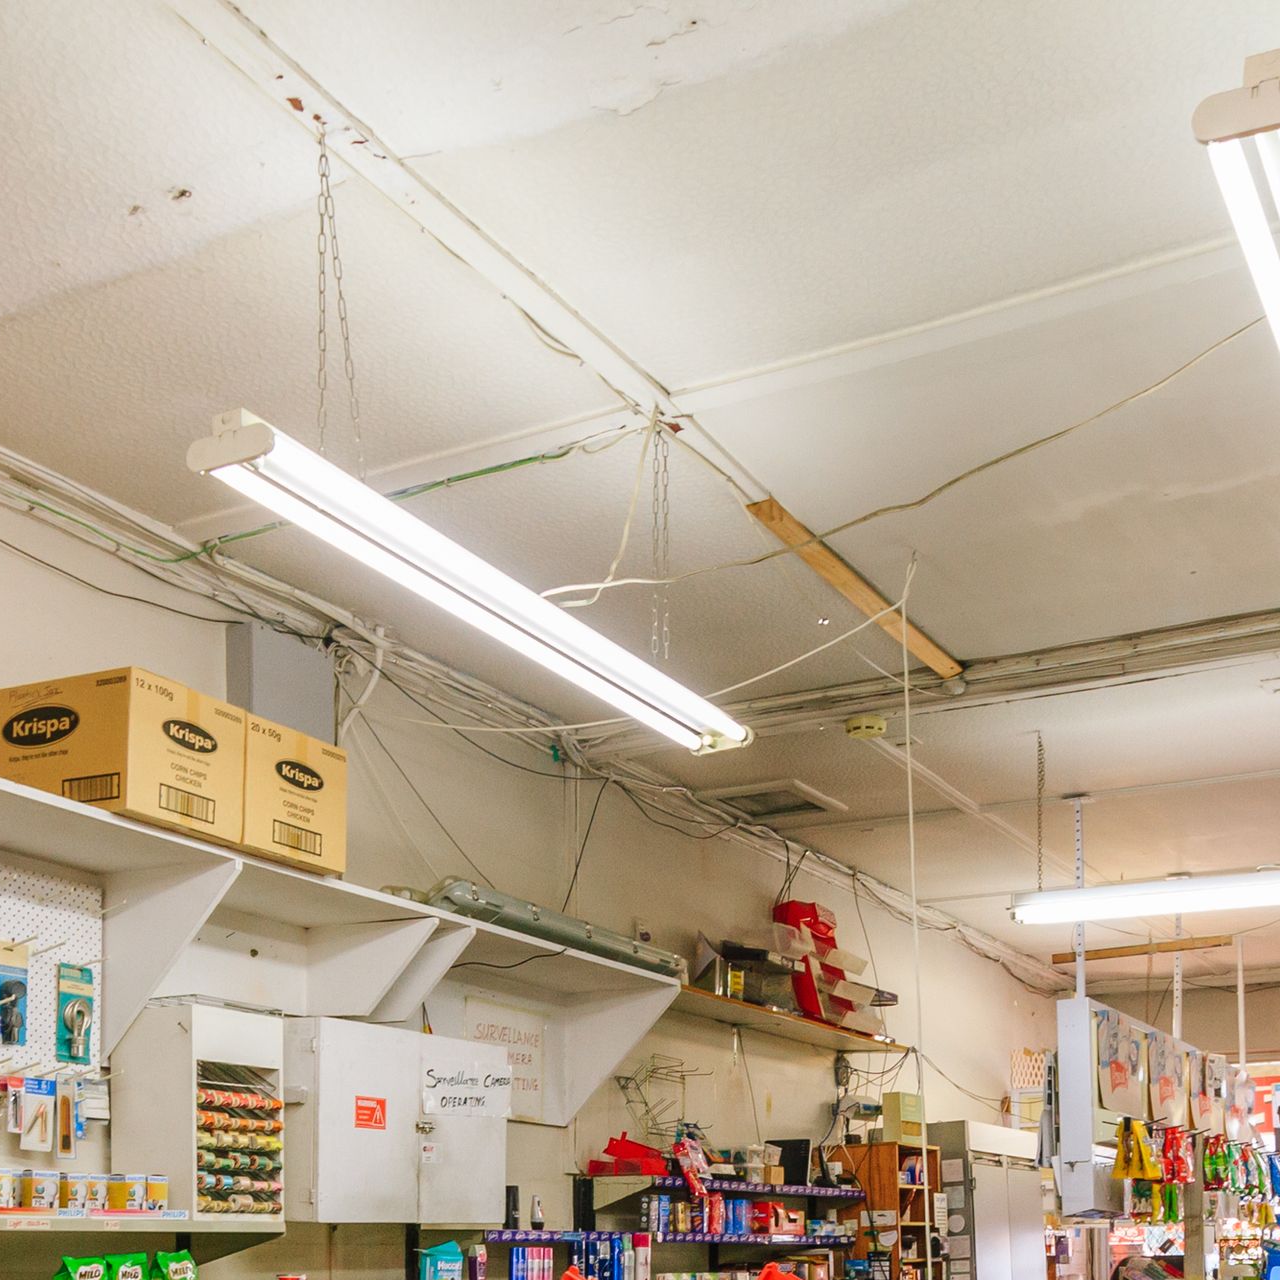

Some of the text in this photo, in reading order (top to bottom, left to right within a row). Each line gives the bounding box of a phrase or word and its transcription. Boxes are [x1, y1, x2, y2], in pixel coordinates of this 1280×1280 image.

[136, 678, 145, 688] 12
[154, 685, 174, 701] 100g
[12, 716, 70, 739] Krispa
[250, 722, 260, 732] 20
[169, 724, 212, 751] Krispa
[171, 762, 207, 780] CORN CHIPS
[282, 765, 320, 787] Krispa
[507, 1051, 532, 1065] MERA
[78, 1268, 101, 1280] MILO
